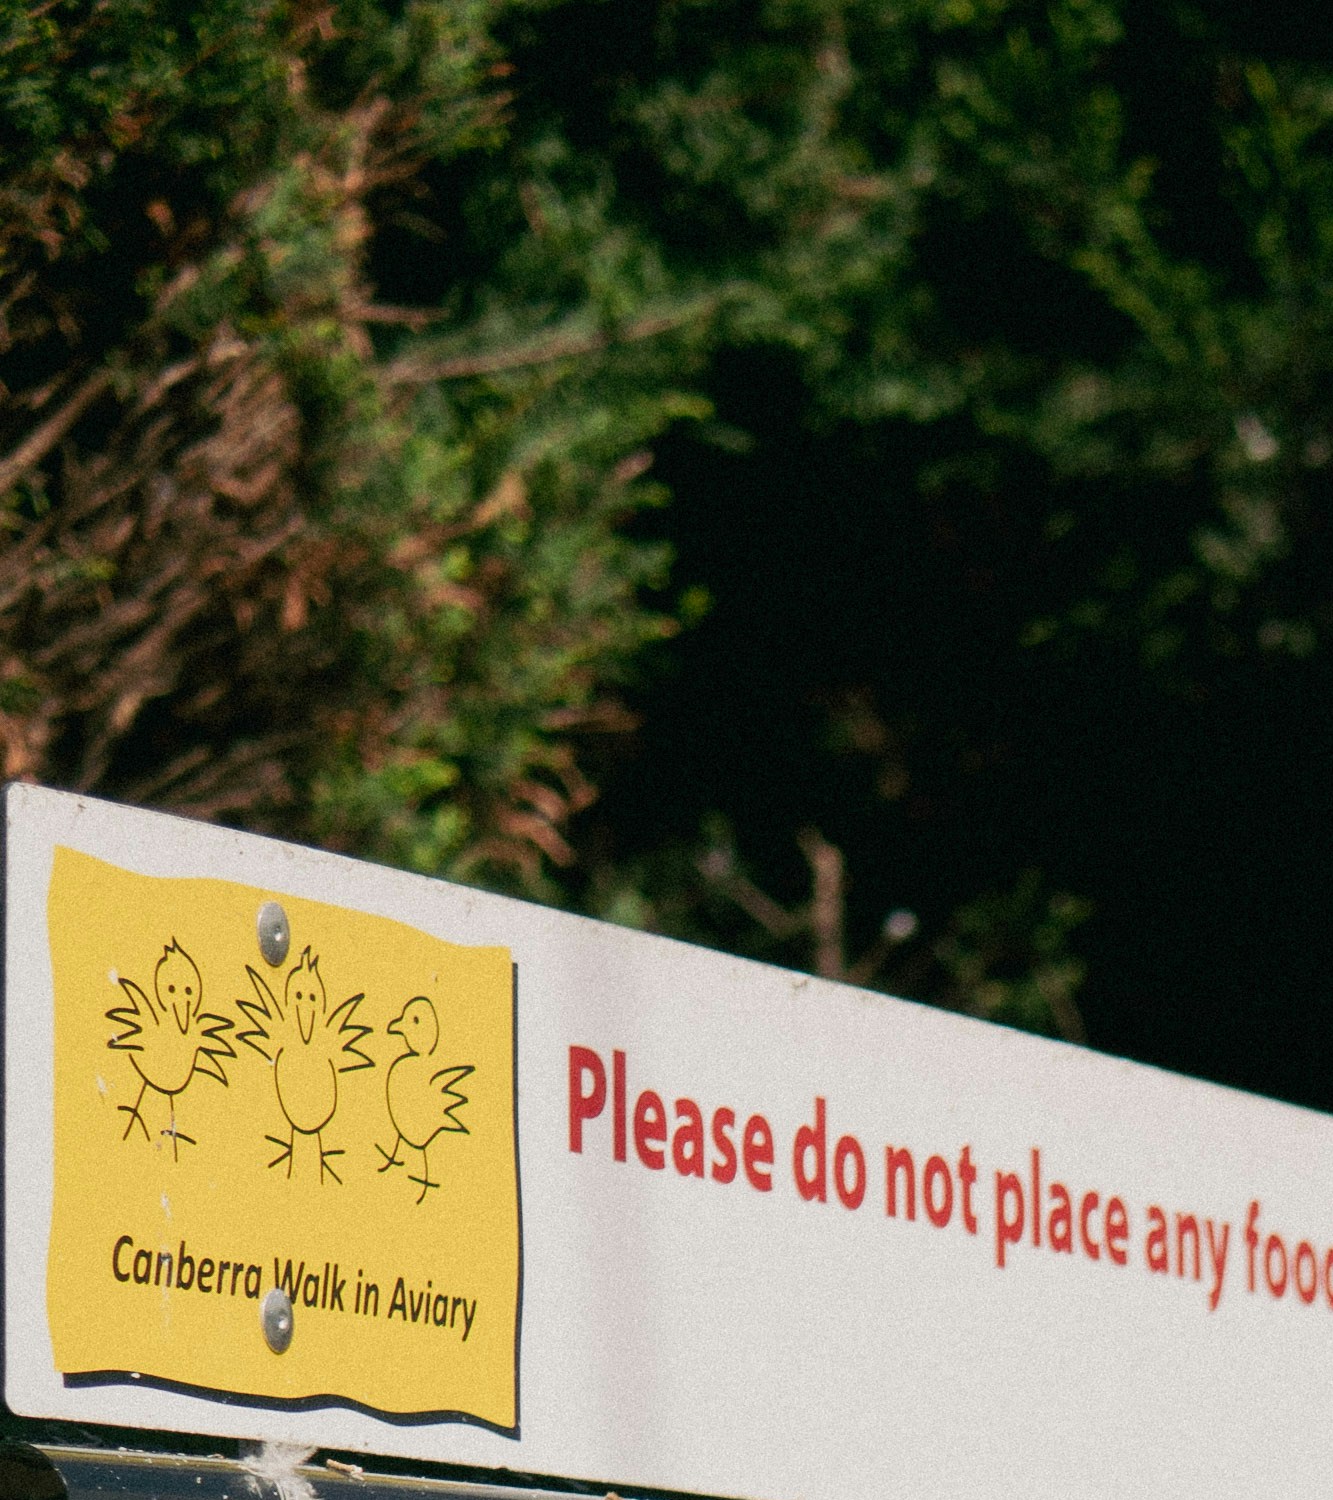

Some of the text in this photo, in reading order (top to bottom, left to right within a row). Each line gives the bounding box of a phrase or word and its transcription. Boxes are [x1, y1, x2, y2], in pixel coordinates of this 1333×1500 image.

[568, 1045, 775, 1192] Please
[792, 1096, 867, 1211] do
[885, 1144, 977, 1236] not
[995, 1147, 1129, 1269] place
[1146, 1203, 1232, 1311] any
[112, 1234, 478, 1342] Canberra Walk in Aviary
